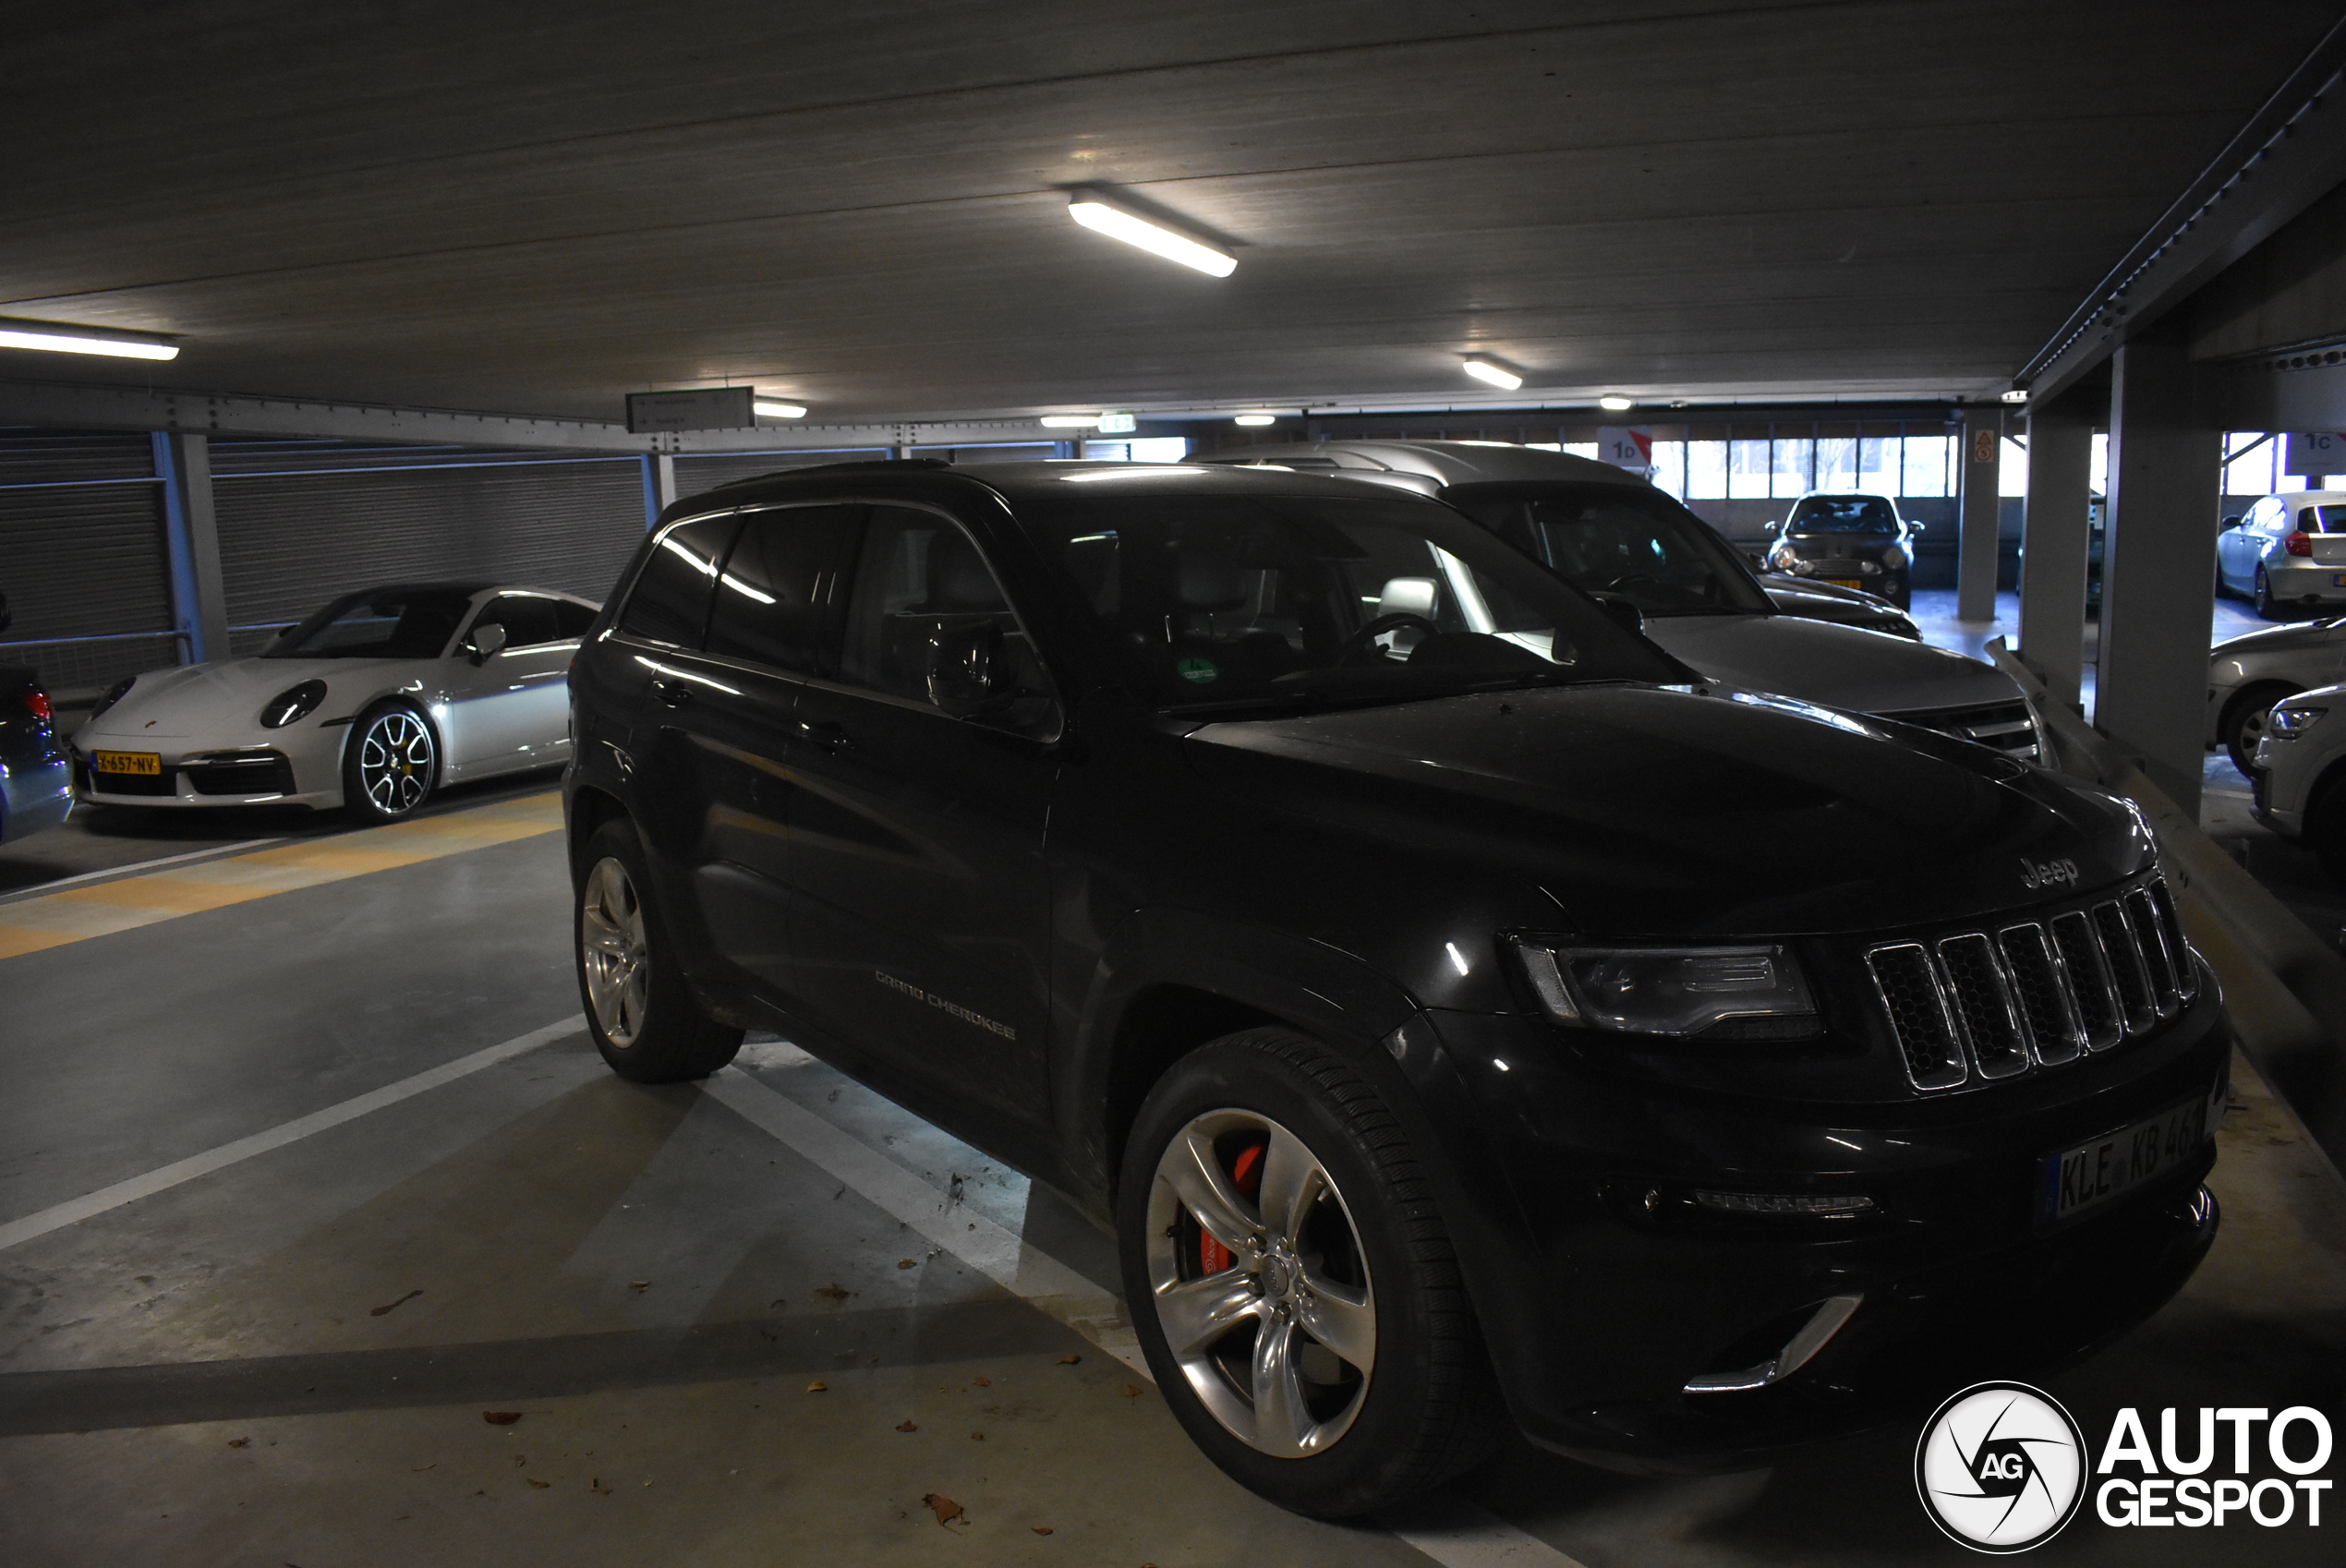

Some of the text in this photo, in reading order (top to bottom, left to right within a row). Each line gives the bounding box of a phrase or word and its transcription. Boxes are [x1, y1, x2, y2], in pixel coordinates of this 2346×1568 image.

[2019, 858, 2079, 888] Jeep
[876, 971, 1016, 1041] GRAND CHEROKEE
[2060, 1142, 2113, 1212] KLE
[2130, 1124, 2159, 1182] KB
